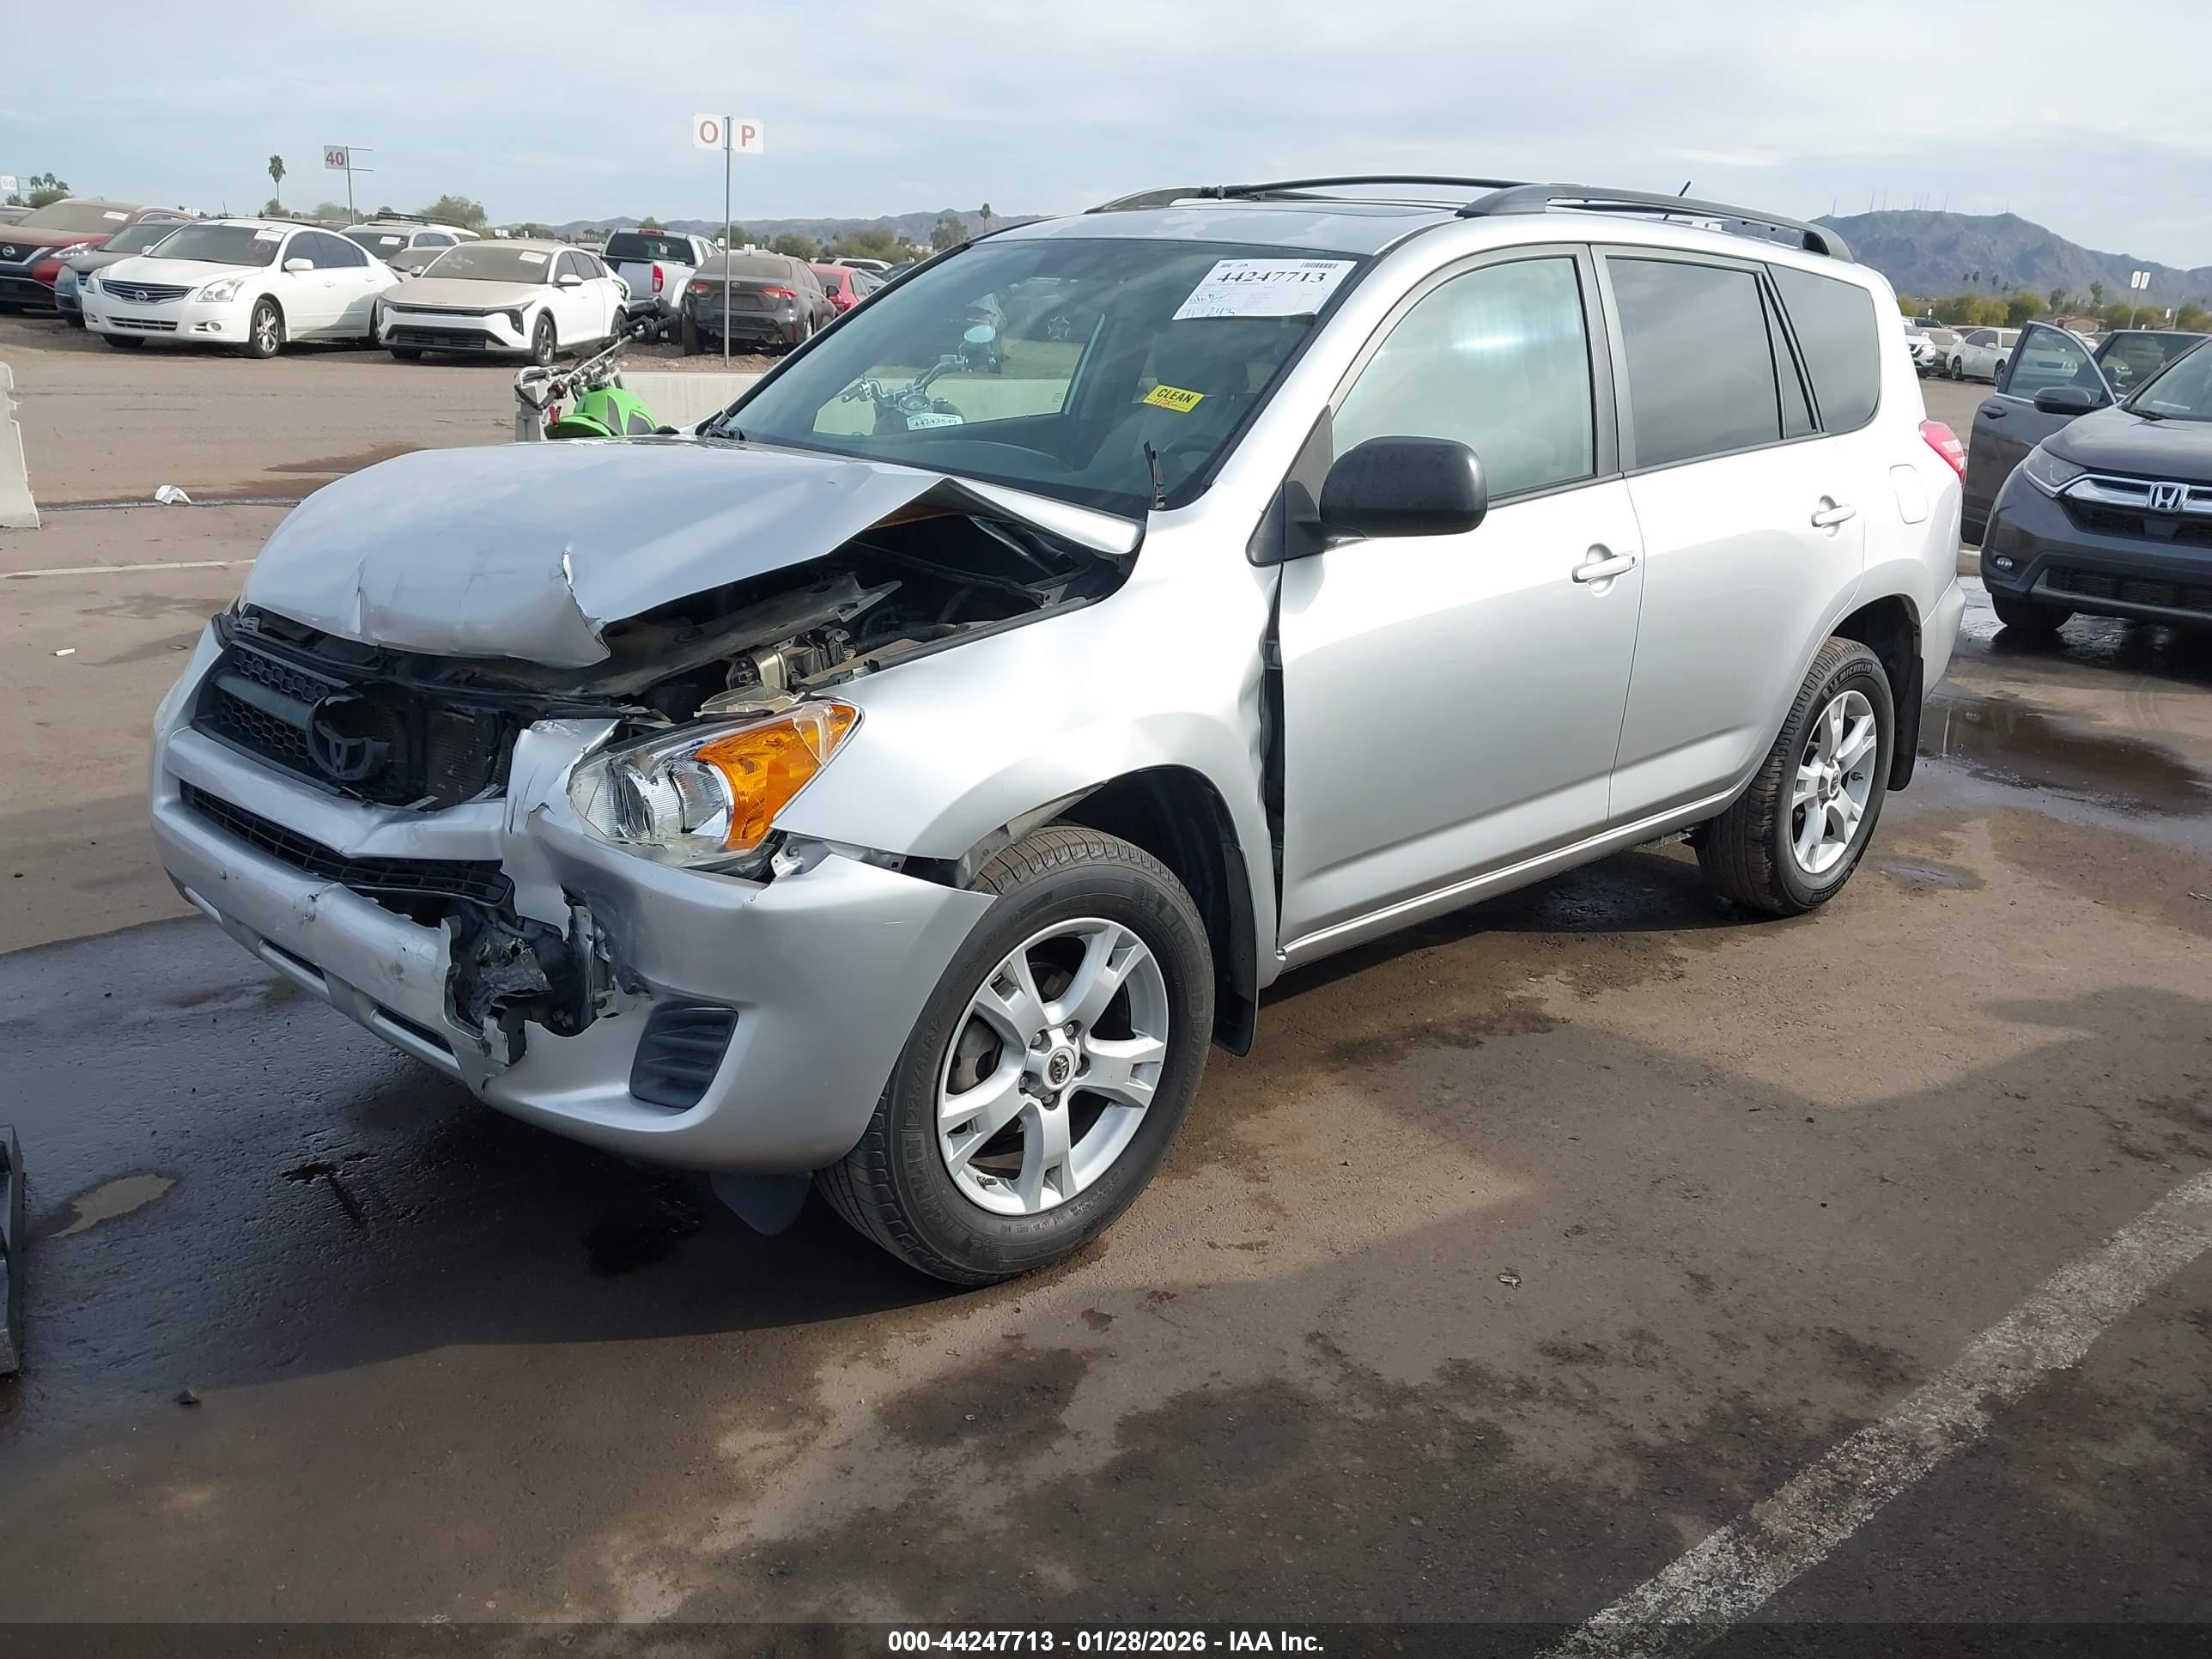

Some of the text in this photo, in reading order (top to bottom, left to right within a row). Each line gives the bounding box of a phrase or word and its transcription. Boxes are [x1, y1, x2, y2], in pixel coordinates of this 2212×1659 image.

[699, 120, 719, 143] O
[741, 125, 756, 147] P
[326, 151, 344, 165] 40
[1217, 271, 1327, 283] 44247713
[1156, 388, 1195, 404] CLEAN
